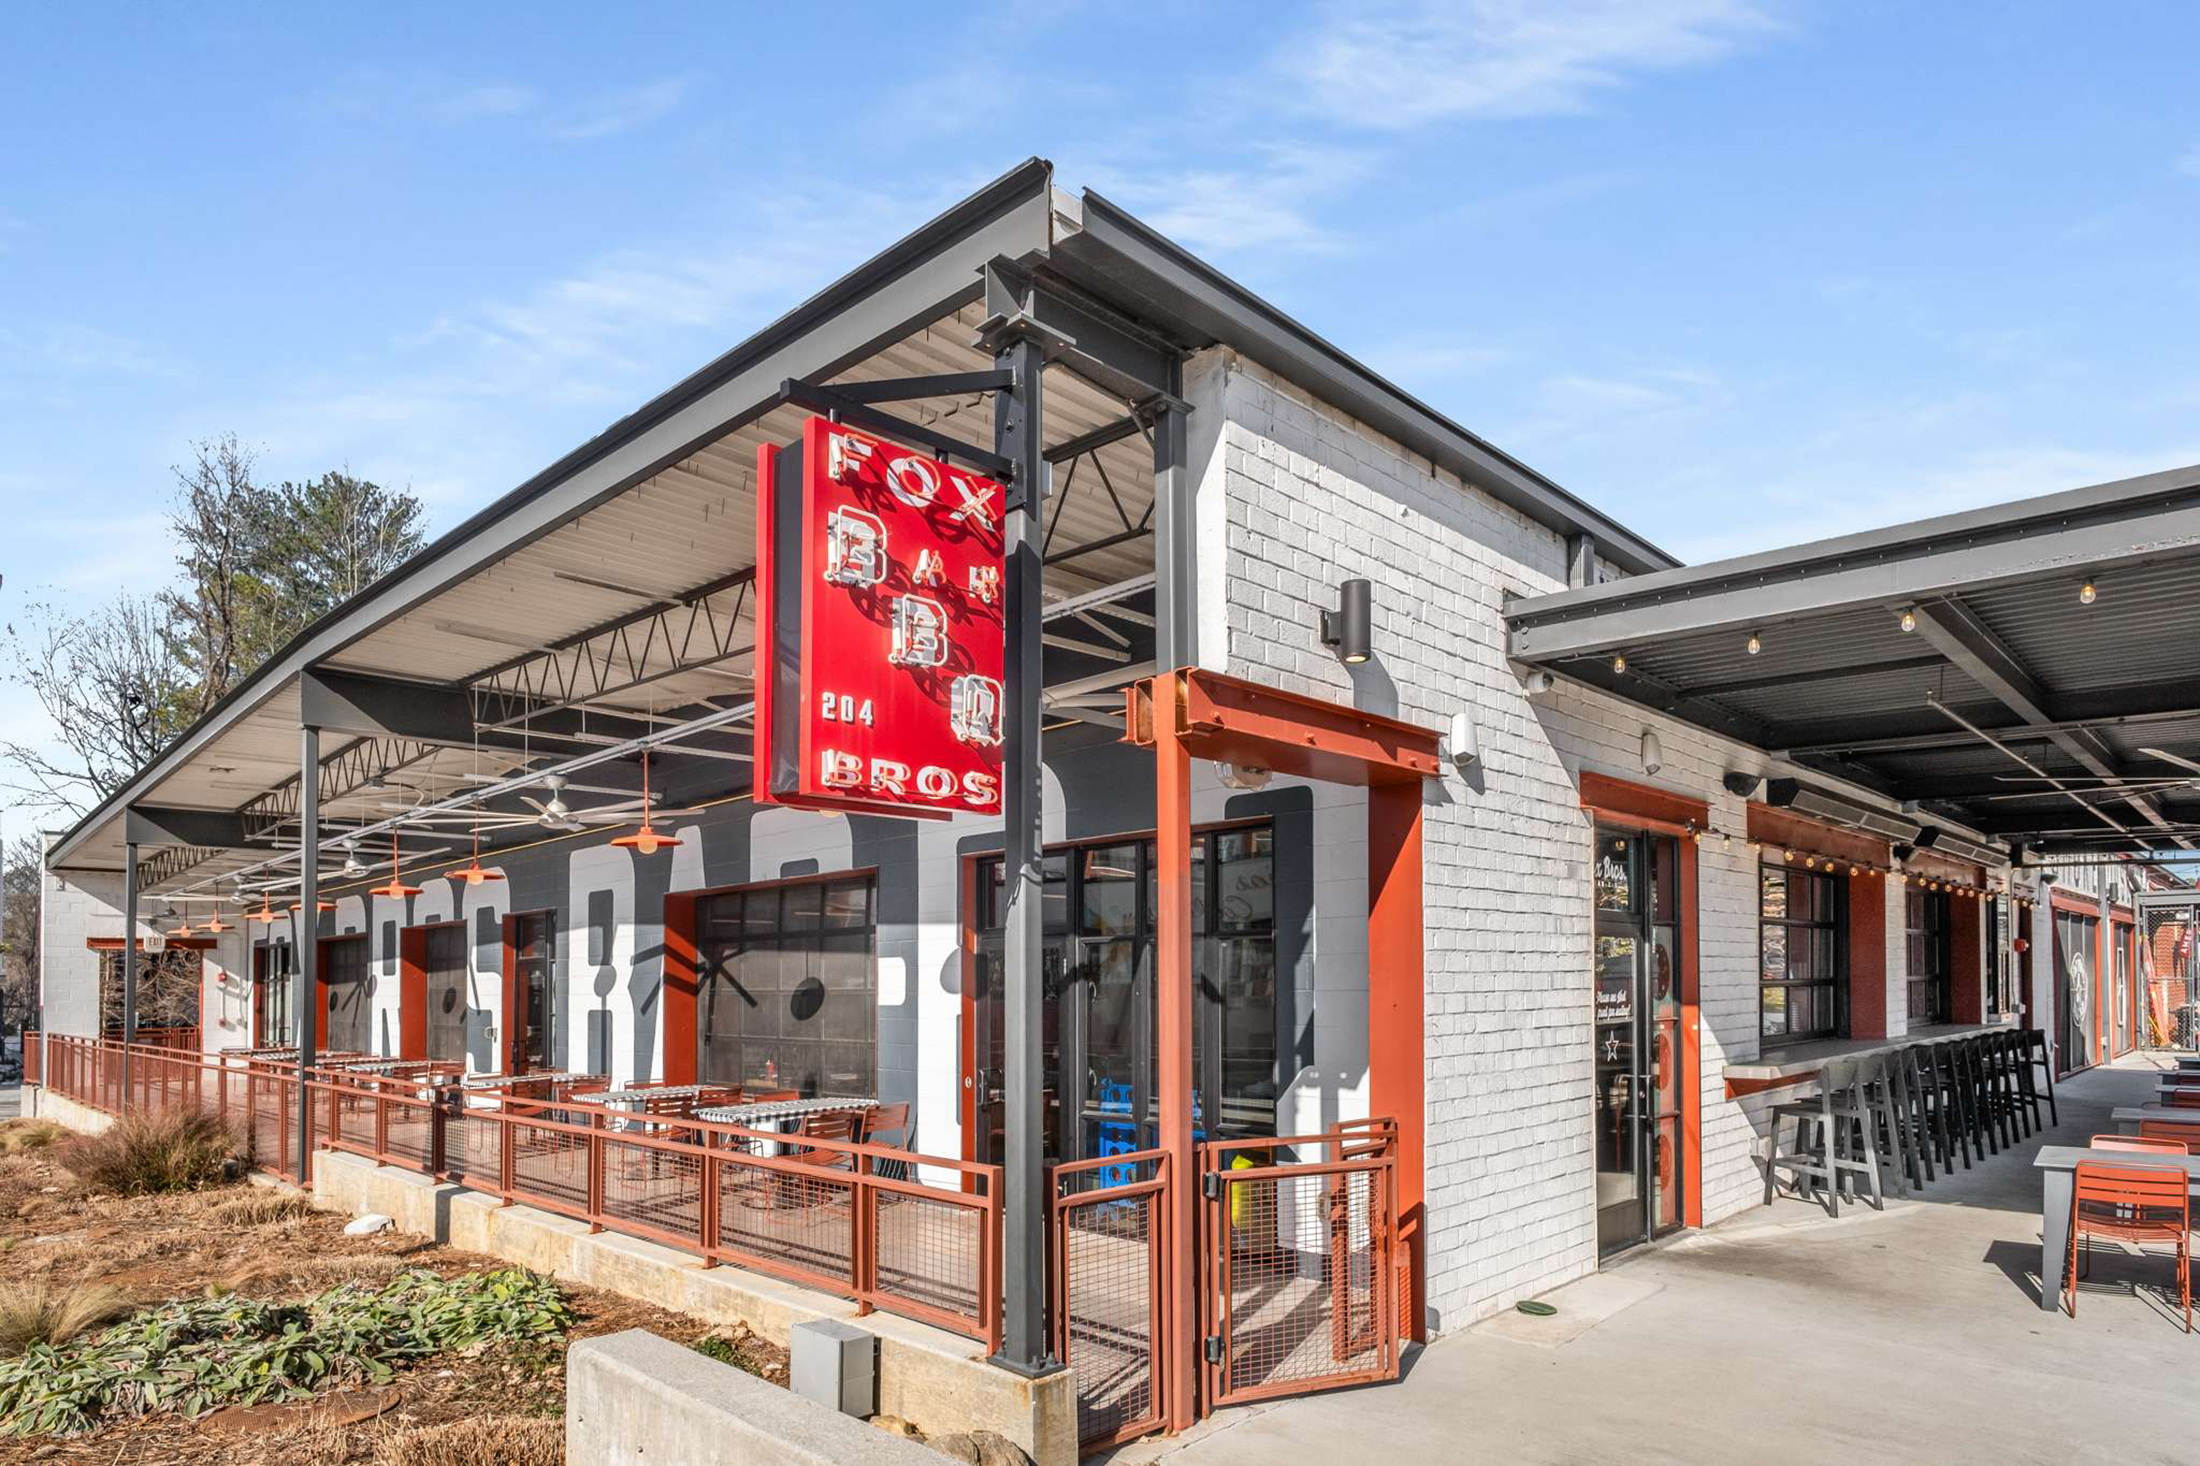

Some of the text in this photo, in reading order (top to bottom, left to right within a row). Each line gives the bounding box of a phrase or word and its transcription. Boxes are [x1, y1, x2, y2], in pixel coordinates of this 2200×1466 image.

[828, 431, 998, 533] FOX
[888, 594, 948, 666] B
[821, 691, 874, 726] 204
[821, 748, 999, 805] BROS
